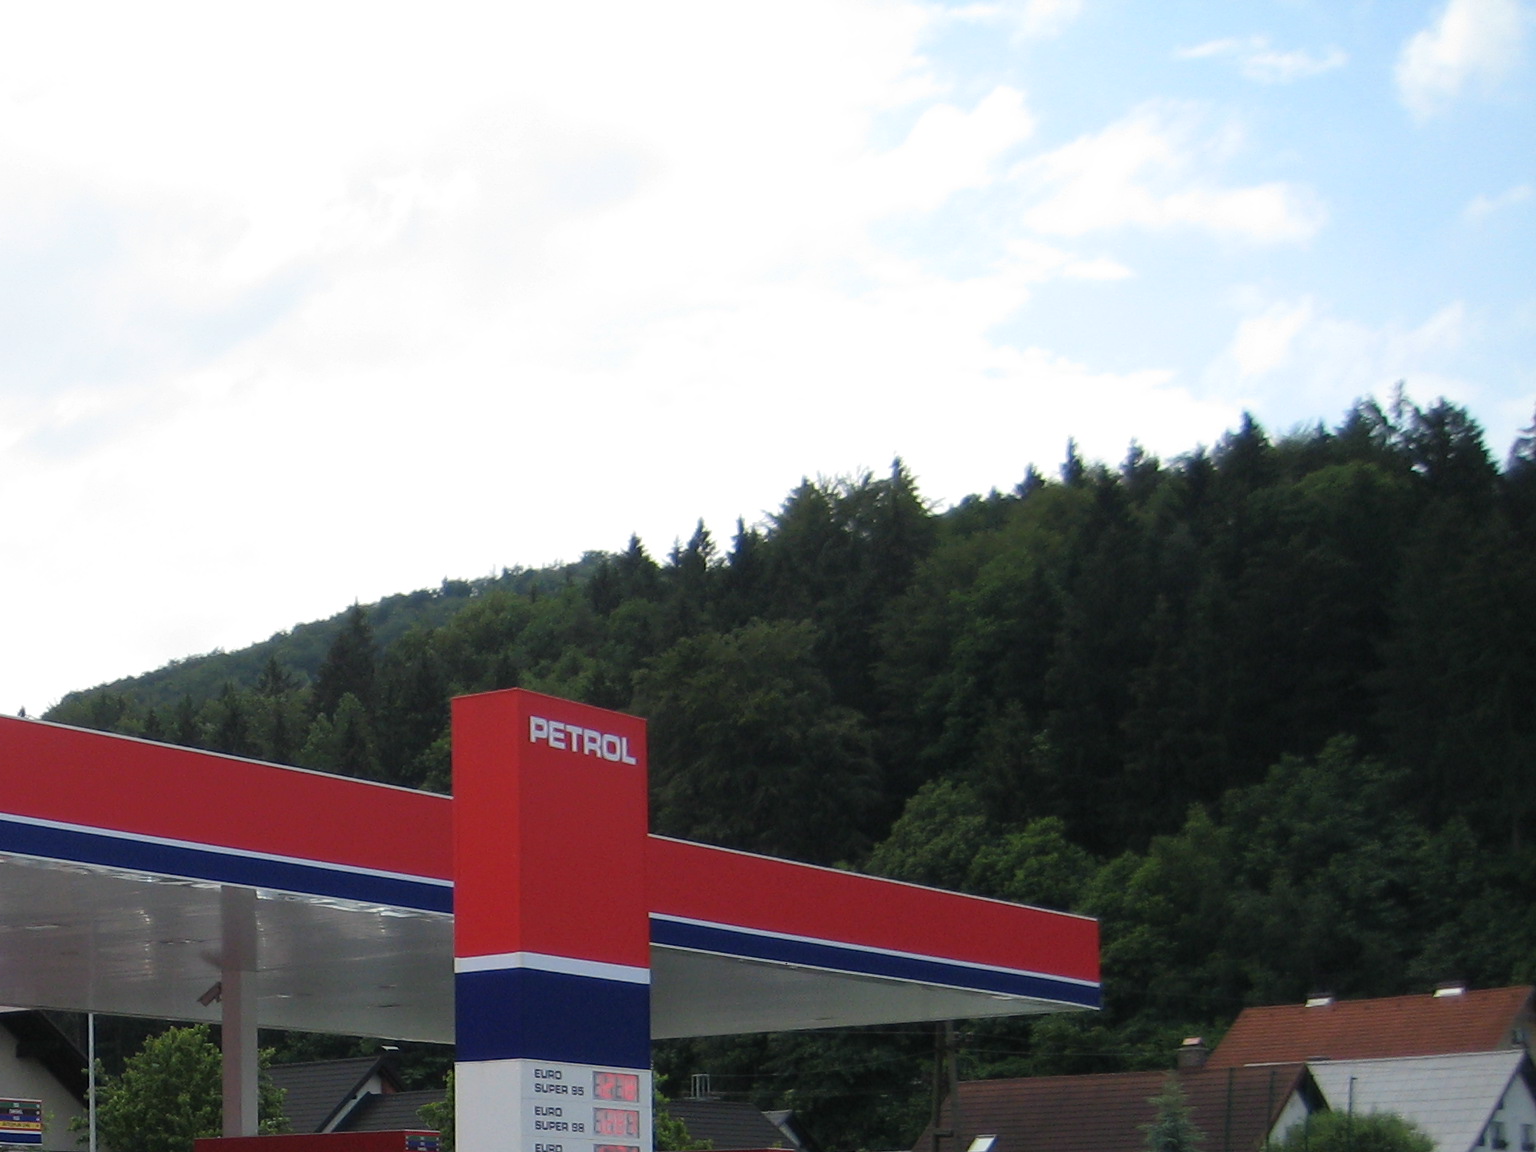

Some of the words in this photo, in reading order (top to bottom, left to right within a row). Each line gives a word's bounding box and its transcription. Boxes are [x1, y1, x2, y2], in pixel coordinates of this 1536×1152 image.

[529, 715, 637, 765] PETROL
[534, 1068, 562, 1080] EURO
[534, 1083, 568, 1095] SUPER
[571, 1086, 584, 1096] 95
[535, 1106, 562, 1117] EURO
[535, 1120, 568, 1132] SUPER
[572, 1122, 585, 1132] 98
